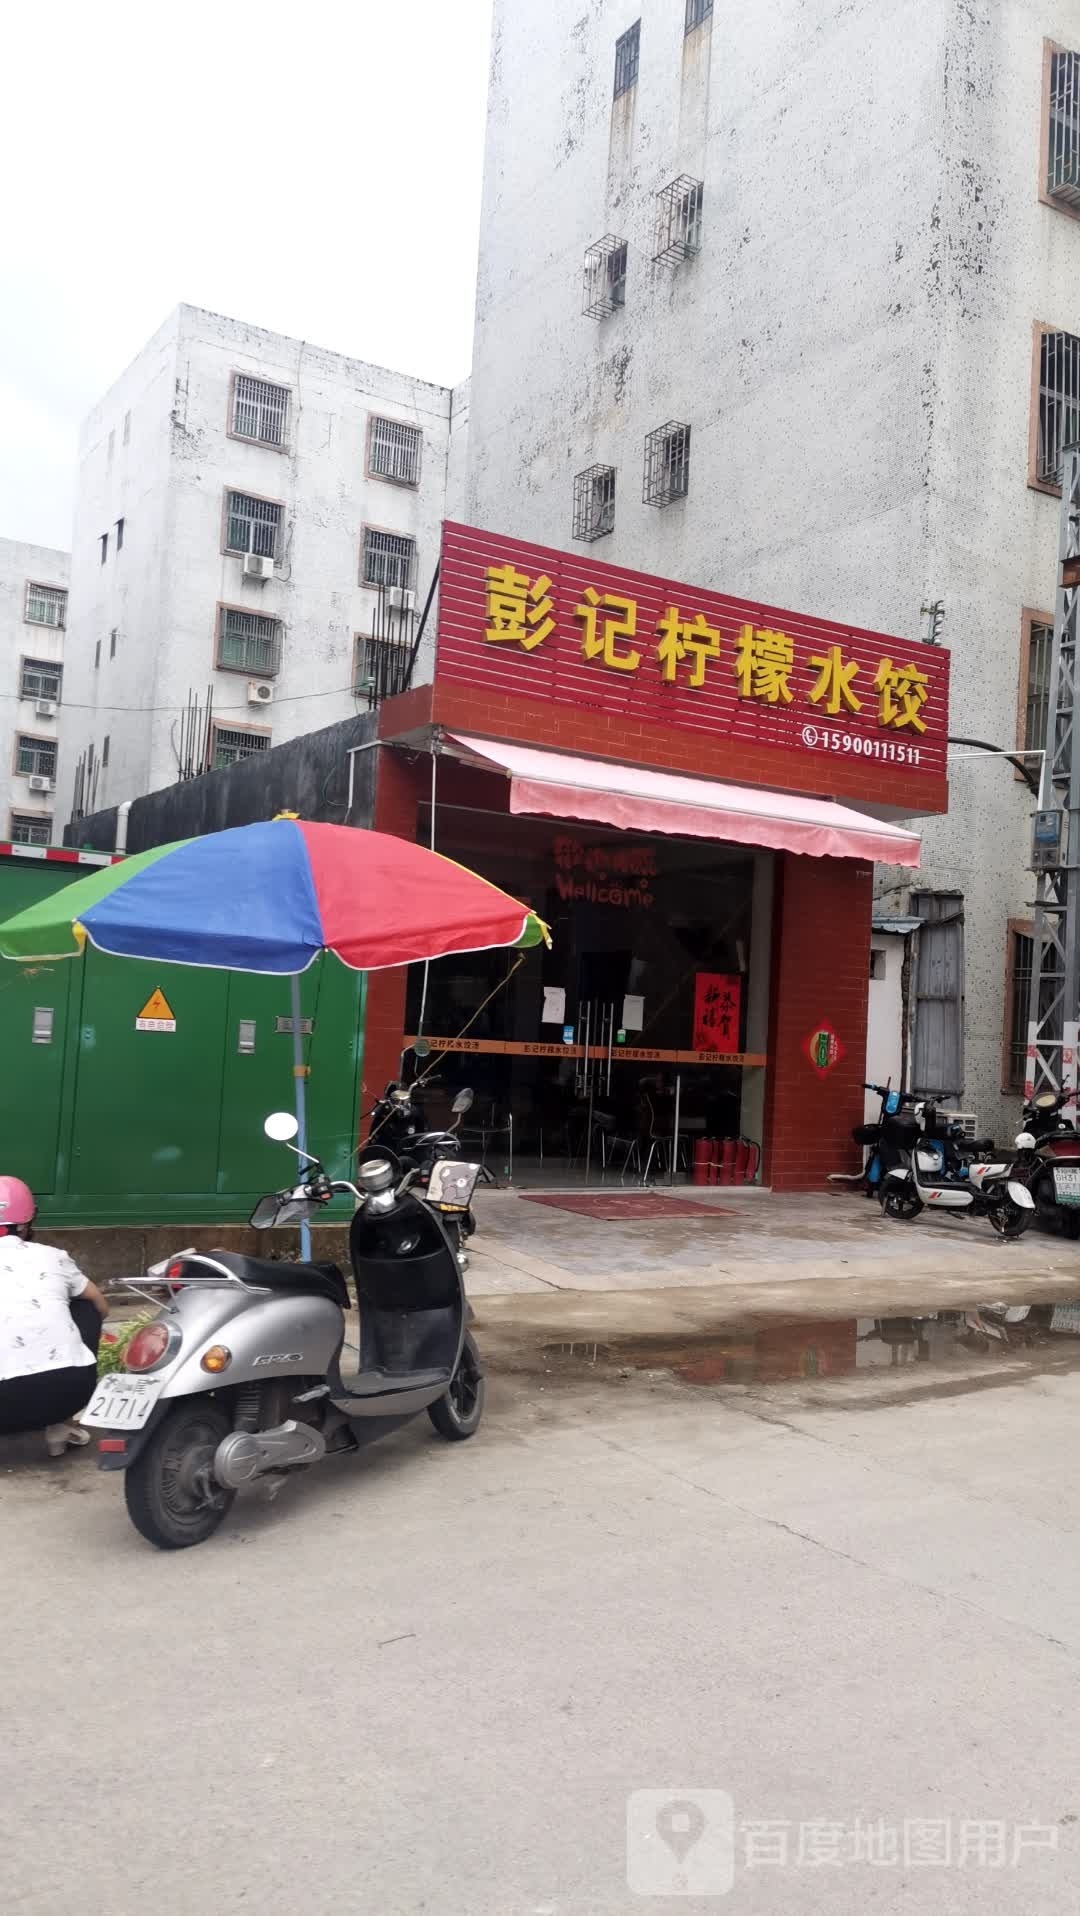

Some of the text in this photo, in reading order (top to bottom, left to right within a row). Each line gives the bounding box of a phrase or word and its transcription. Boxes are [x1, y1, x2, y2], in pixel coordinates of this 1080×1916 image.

[483, 565, 929, 734] 彭记柠檬水饺
[822, 731, 920, 765] 15900111511
